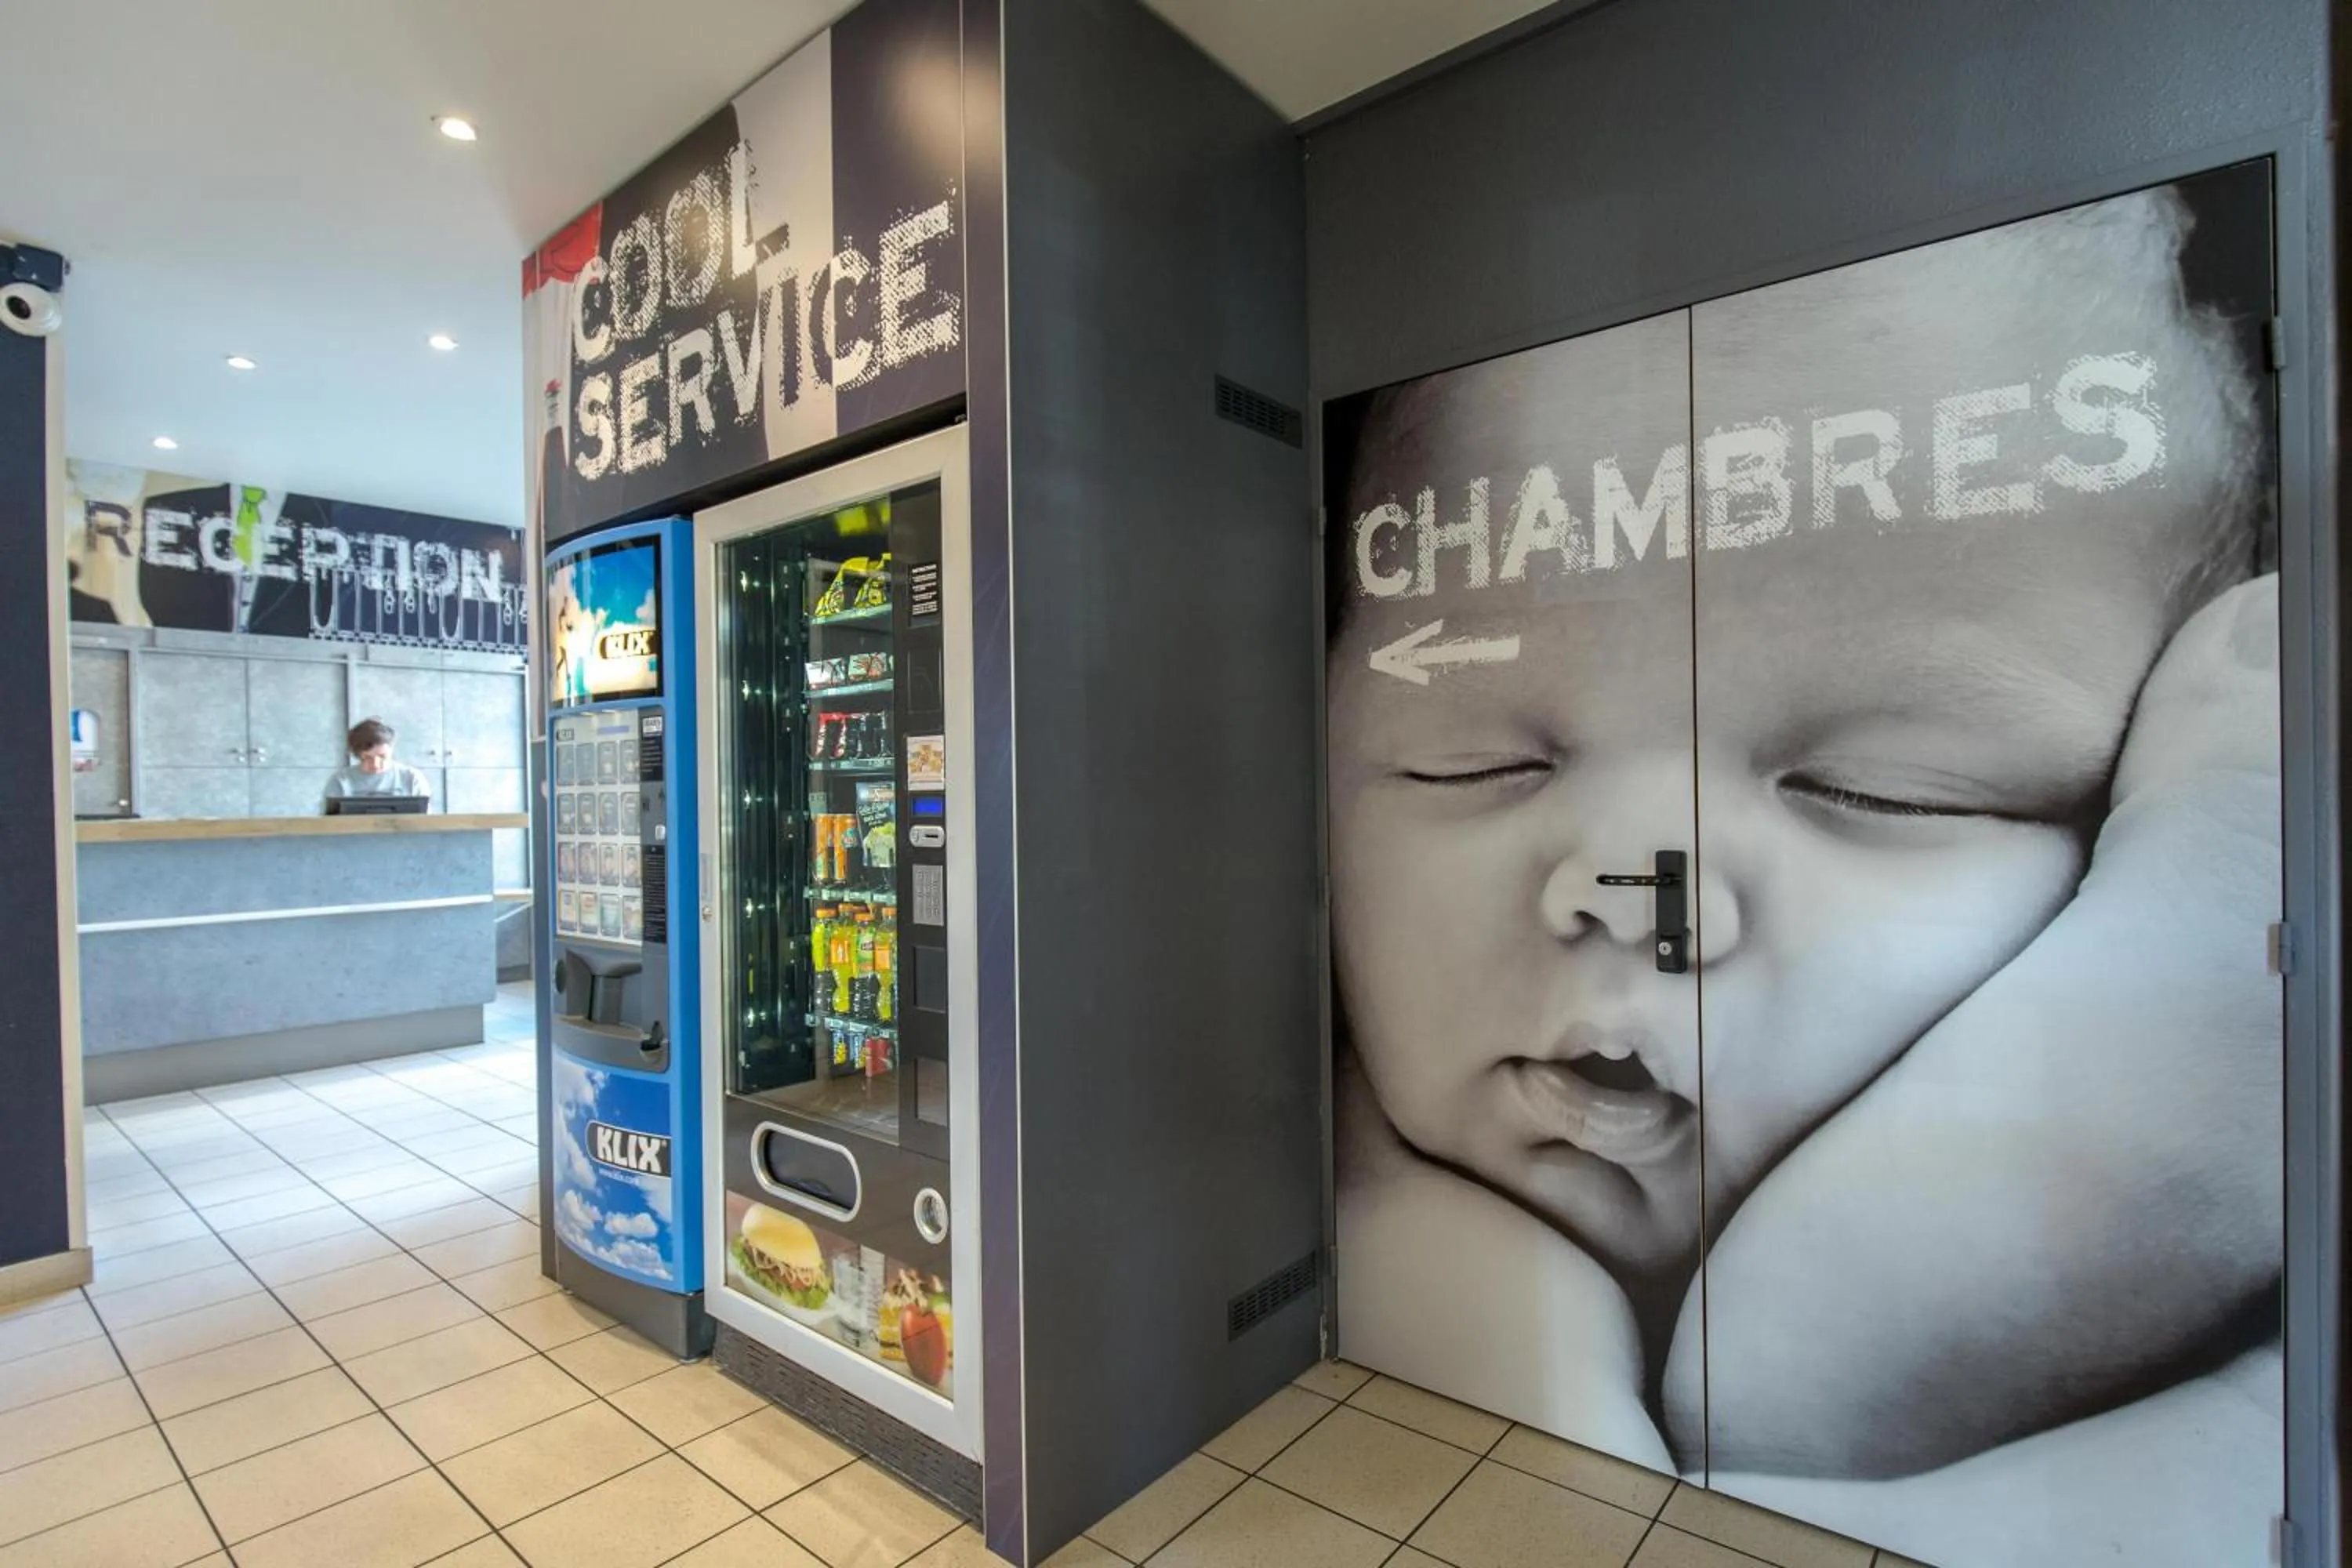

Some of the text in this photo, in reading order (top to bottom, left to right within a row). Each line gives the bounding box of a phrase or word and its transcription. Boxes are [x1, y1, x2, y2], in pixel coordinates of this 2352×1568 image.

[572, 141, 790, 364] COOL
[574, 196, 961, 479] SERVICE
[85, 500, 503, 603] RECEPTION
[1352, 353, 2165, 601] CHAMBRES
[597, 1127, 661, 1173] KLIX
